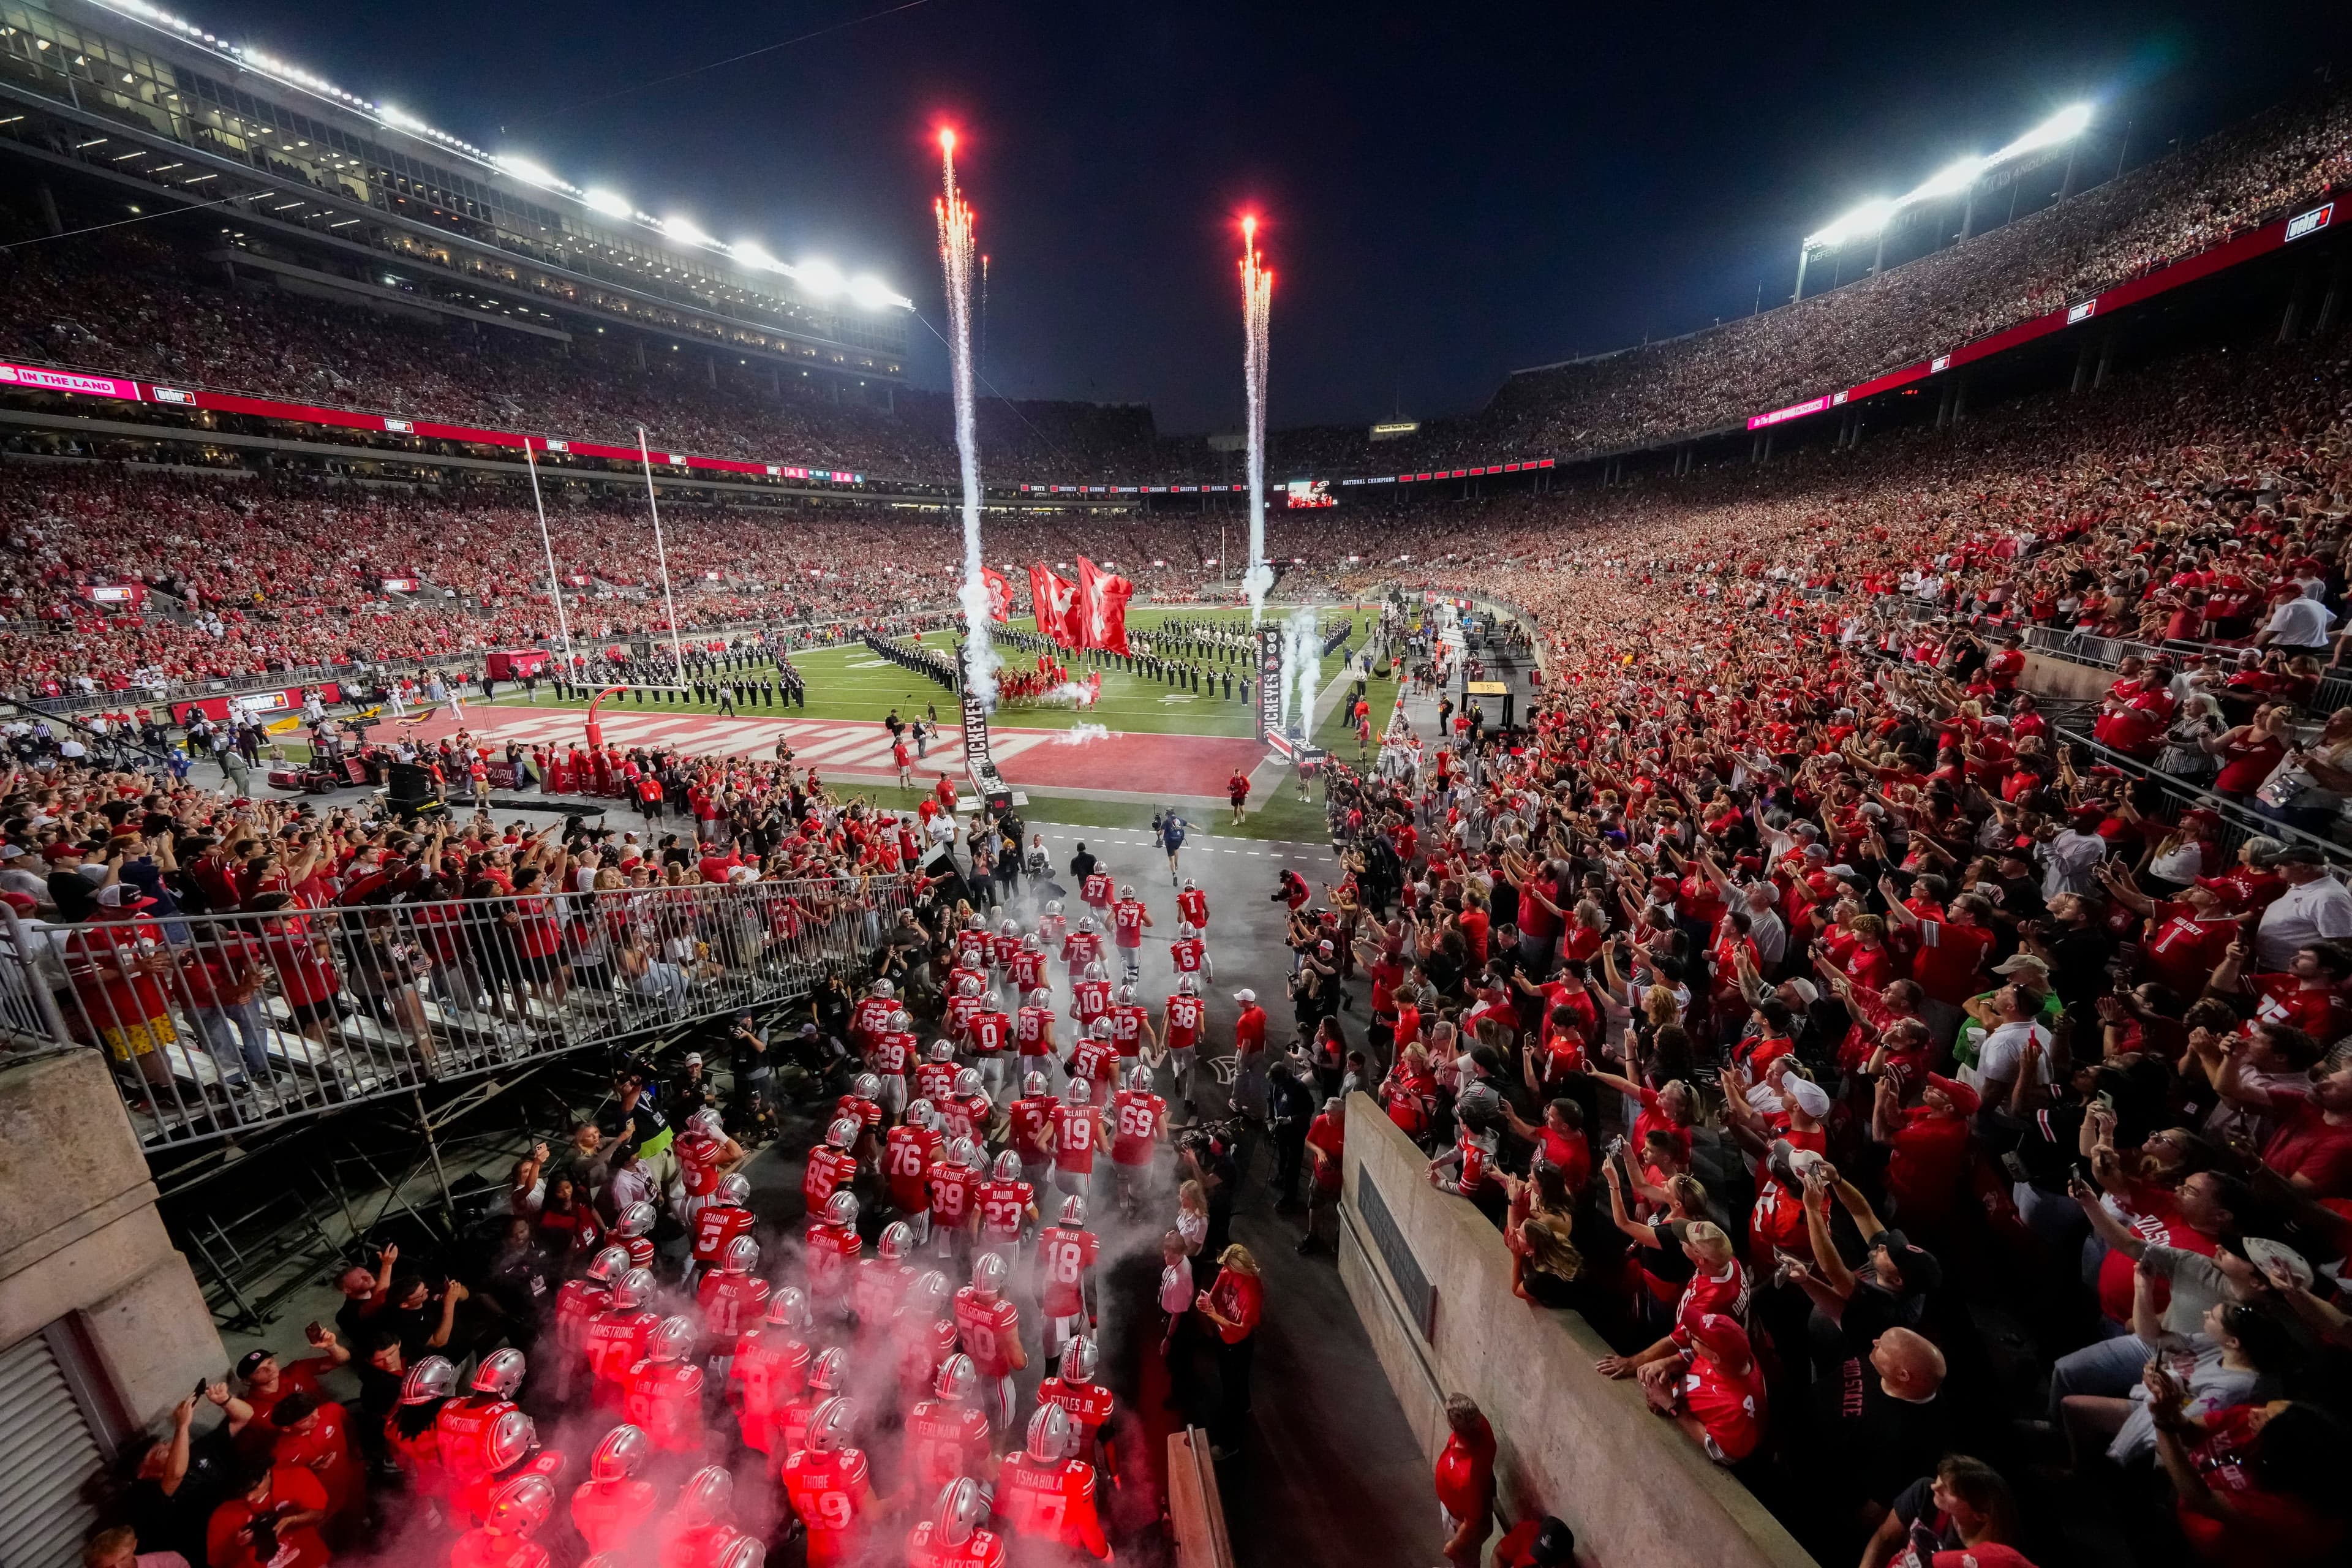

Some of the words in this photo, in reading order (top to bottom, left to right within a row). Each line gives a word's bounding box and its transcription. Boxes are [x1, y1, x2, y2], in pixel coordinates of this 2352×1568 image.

[2289, 212, 2320, 238] weber
[22, 371, 39, 382] IN
[42, 374, 70, 386] THE
[73, 379, 111, 391] LAND
[156, 388, 186, 402] weber
[1367, 476, 1395, 484] CHAMPIONS
[241, 695, 276, 710] weber
[1264, 674, 1279, 738] UCKEYES
[966, 698, 987, 762] UCKEYES
[1088, 881, 1105, 897] 97
[1189, 897, 1196, 913] 1
[1118, 909, 1139, 927] 67
[2183, 922, 2204, 936] STATE
[2156, 927, 2184, 954] 1
[1001, 948, 1008, 959] 1
[1069, 943, 1091, 962] 75
[1181, 948, 1195, 967] 6
[1016, 964, 1035, 984] 14
[1082, 991, 1102, 1013] 10
[862, 1009, 889, 1032] 62
[1172, 1004, 1196, 1028] 38
[982, 1023, 998, 1048] 0
[1113, 1016, 1137, 1039] 42
[878, 1045, 905, 1070] 29
[1079, 1041, 1107, 1057] MONTGOMERY
[1076, 1052, 1099, 1080] 51
[921, 1076, 950, 1101] 26
[1020, 1101, 1046, 1110] KIENHOLZ
[1130, 1098, 1148, 1107] MOORE
[1026, 1110, 1042, 1140] 3
[1120, 1105, 1153, 1137] 69
[1063, 1118, 1090, 1150] 19
[813, 1150, 839, 1166] CHRISTIAN
[891, 1144, 921, 1177] 76
[807, 1159, 835, 1199] 85
[933, 1168, 967, 1182] VELAZQUEZ
[930, 1180, 964, 1216] 39
[992, 1191, 1014, 1200] BAUDO
[703, 1213, 729, 1224] GRAHAM
[984, 1201, 1022, 1232] 23
[699, 1224, 722, 1252] 5
[812, 1234, 840, 1251] SCHRAMM
[1055, 1231, 1079, 1242] MILLER
[1048, 1241, 1082, 1283] 18
[717, 1283, 737, 1297] MILLS
[562, 1296, 589, 1314] PORTER
[957, 1302, 994, 1325] DELSIGNORE
[708, 1297, 739, 1337] 41
[589, 1323, 636, 1340] ARMSTRONG
[960, 1319, 996, 1361] 50
[586, 1339, 632, 1382] 73
[1049, 1395, 1079, 1411] STYLES
[1081, 1400, 1095, 1414] JR.
[440, 1415, 483, 1434] ARMSTRONG
[919, 1420, 961, 1439] FERLMANN
[802, 1474, 830, 1490] THOBE
[1014, 1469, 1064, 1492] TSHABOLA
[797, 1491, 852, 1530] 49
[1009, 1487, 1067, 1542] 77
